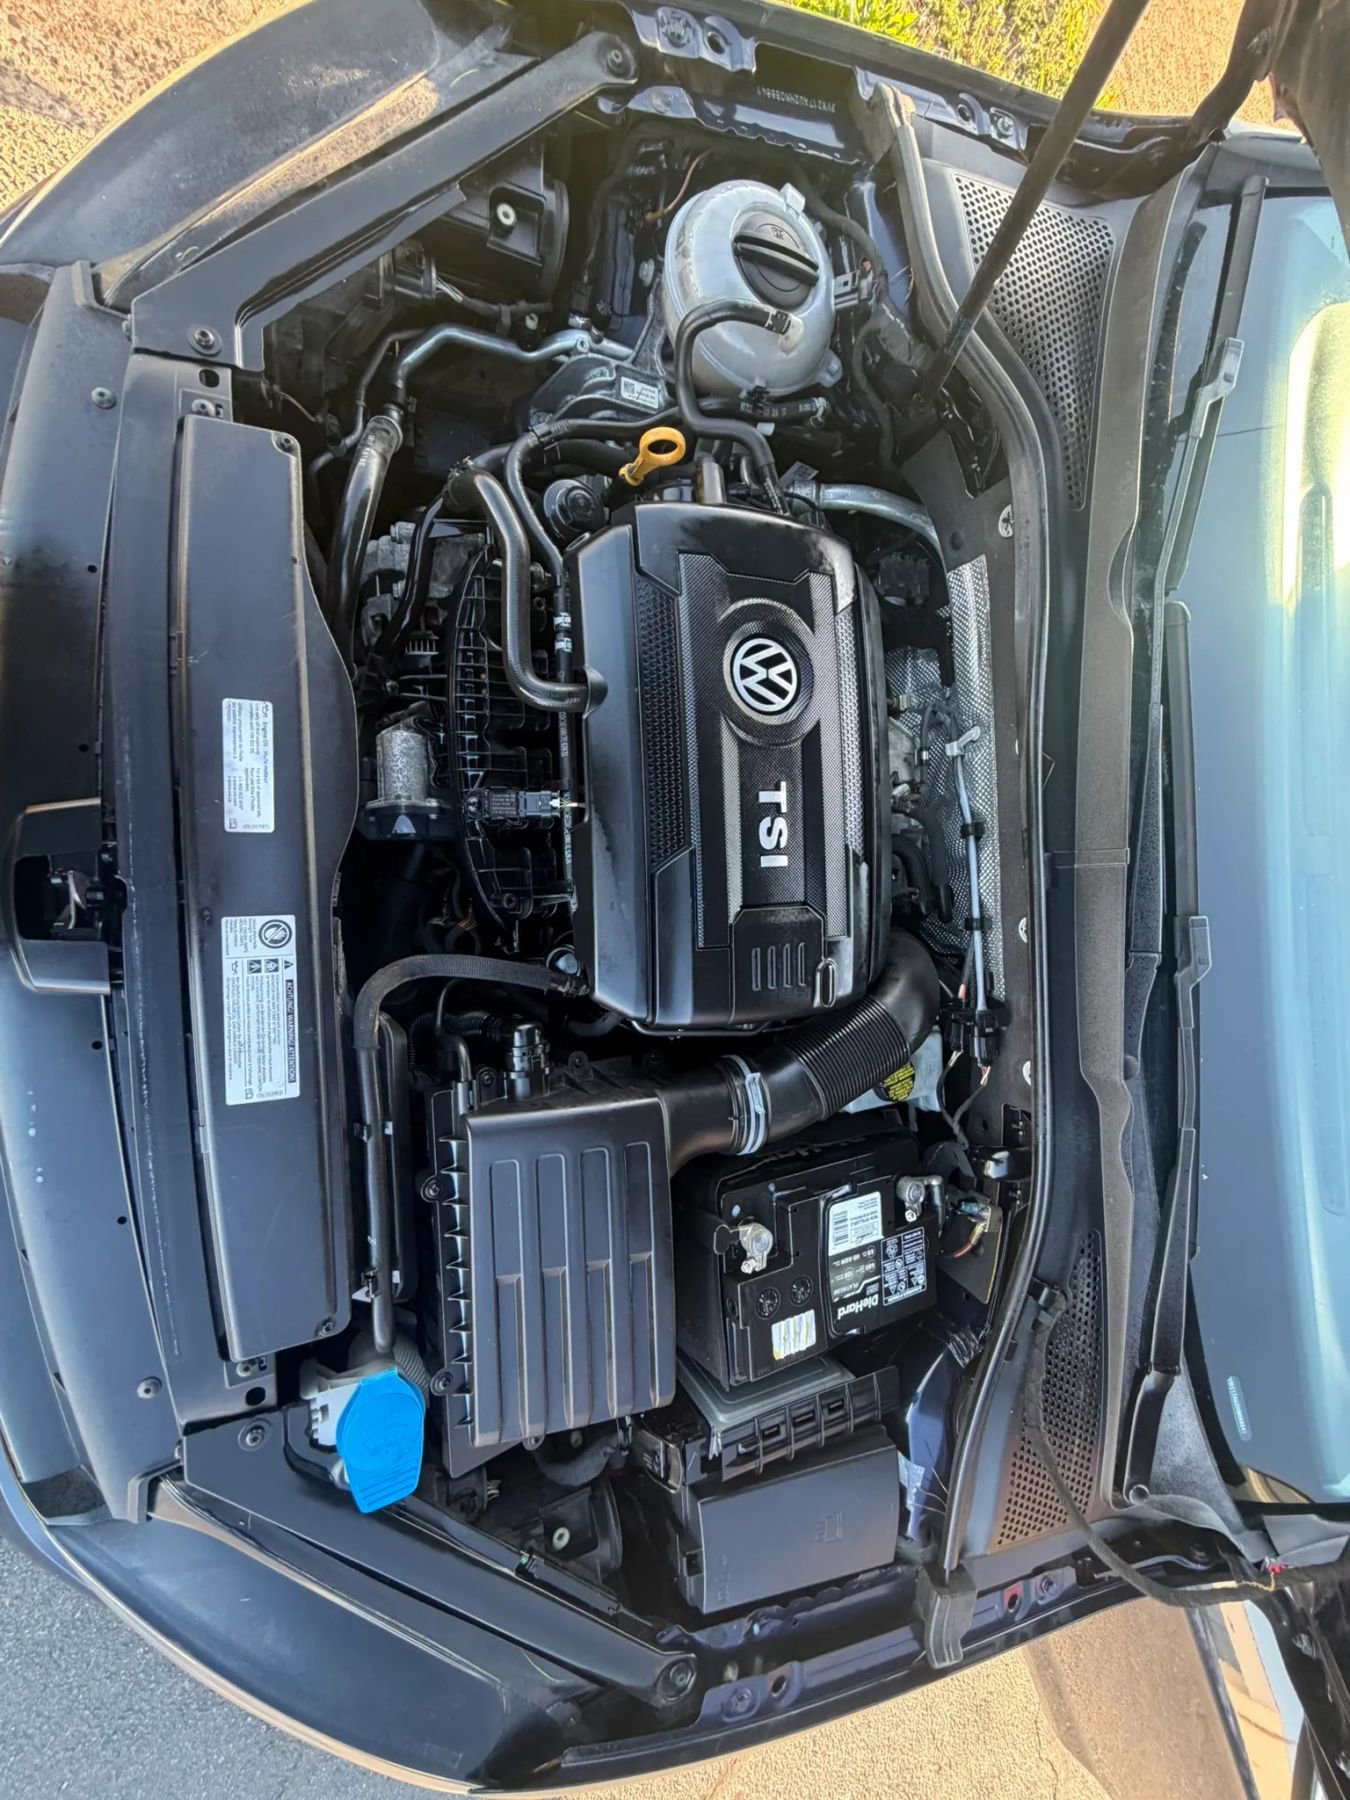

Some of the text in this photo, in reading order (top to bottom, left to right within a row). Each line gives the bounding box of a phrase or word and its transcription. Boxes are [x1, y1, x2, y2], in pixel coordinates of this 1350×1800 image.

[733, 638, 797, 711] VW
[758, 781, 789, 868] TSI
[837, 1293, 879, 1320] DieHard
